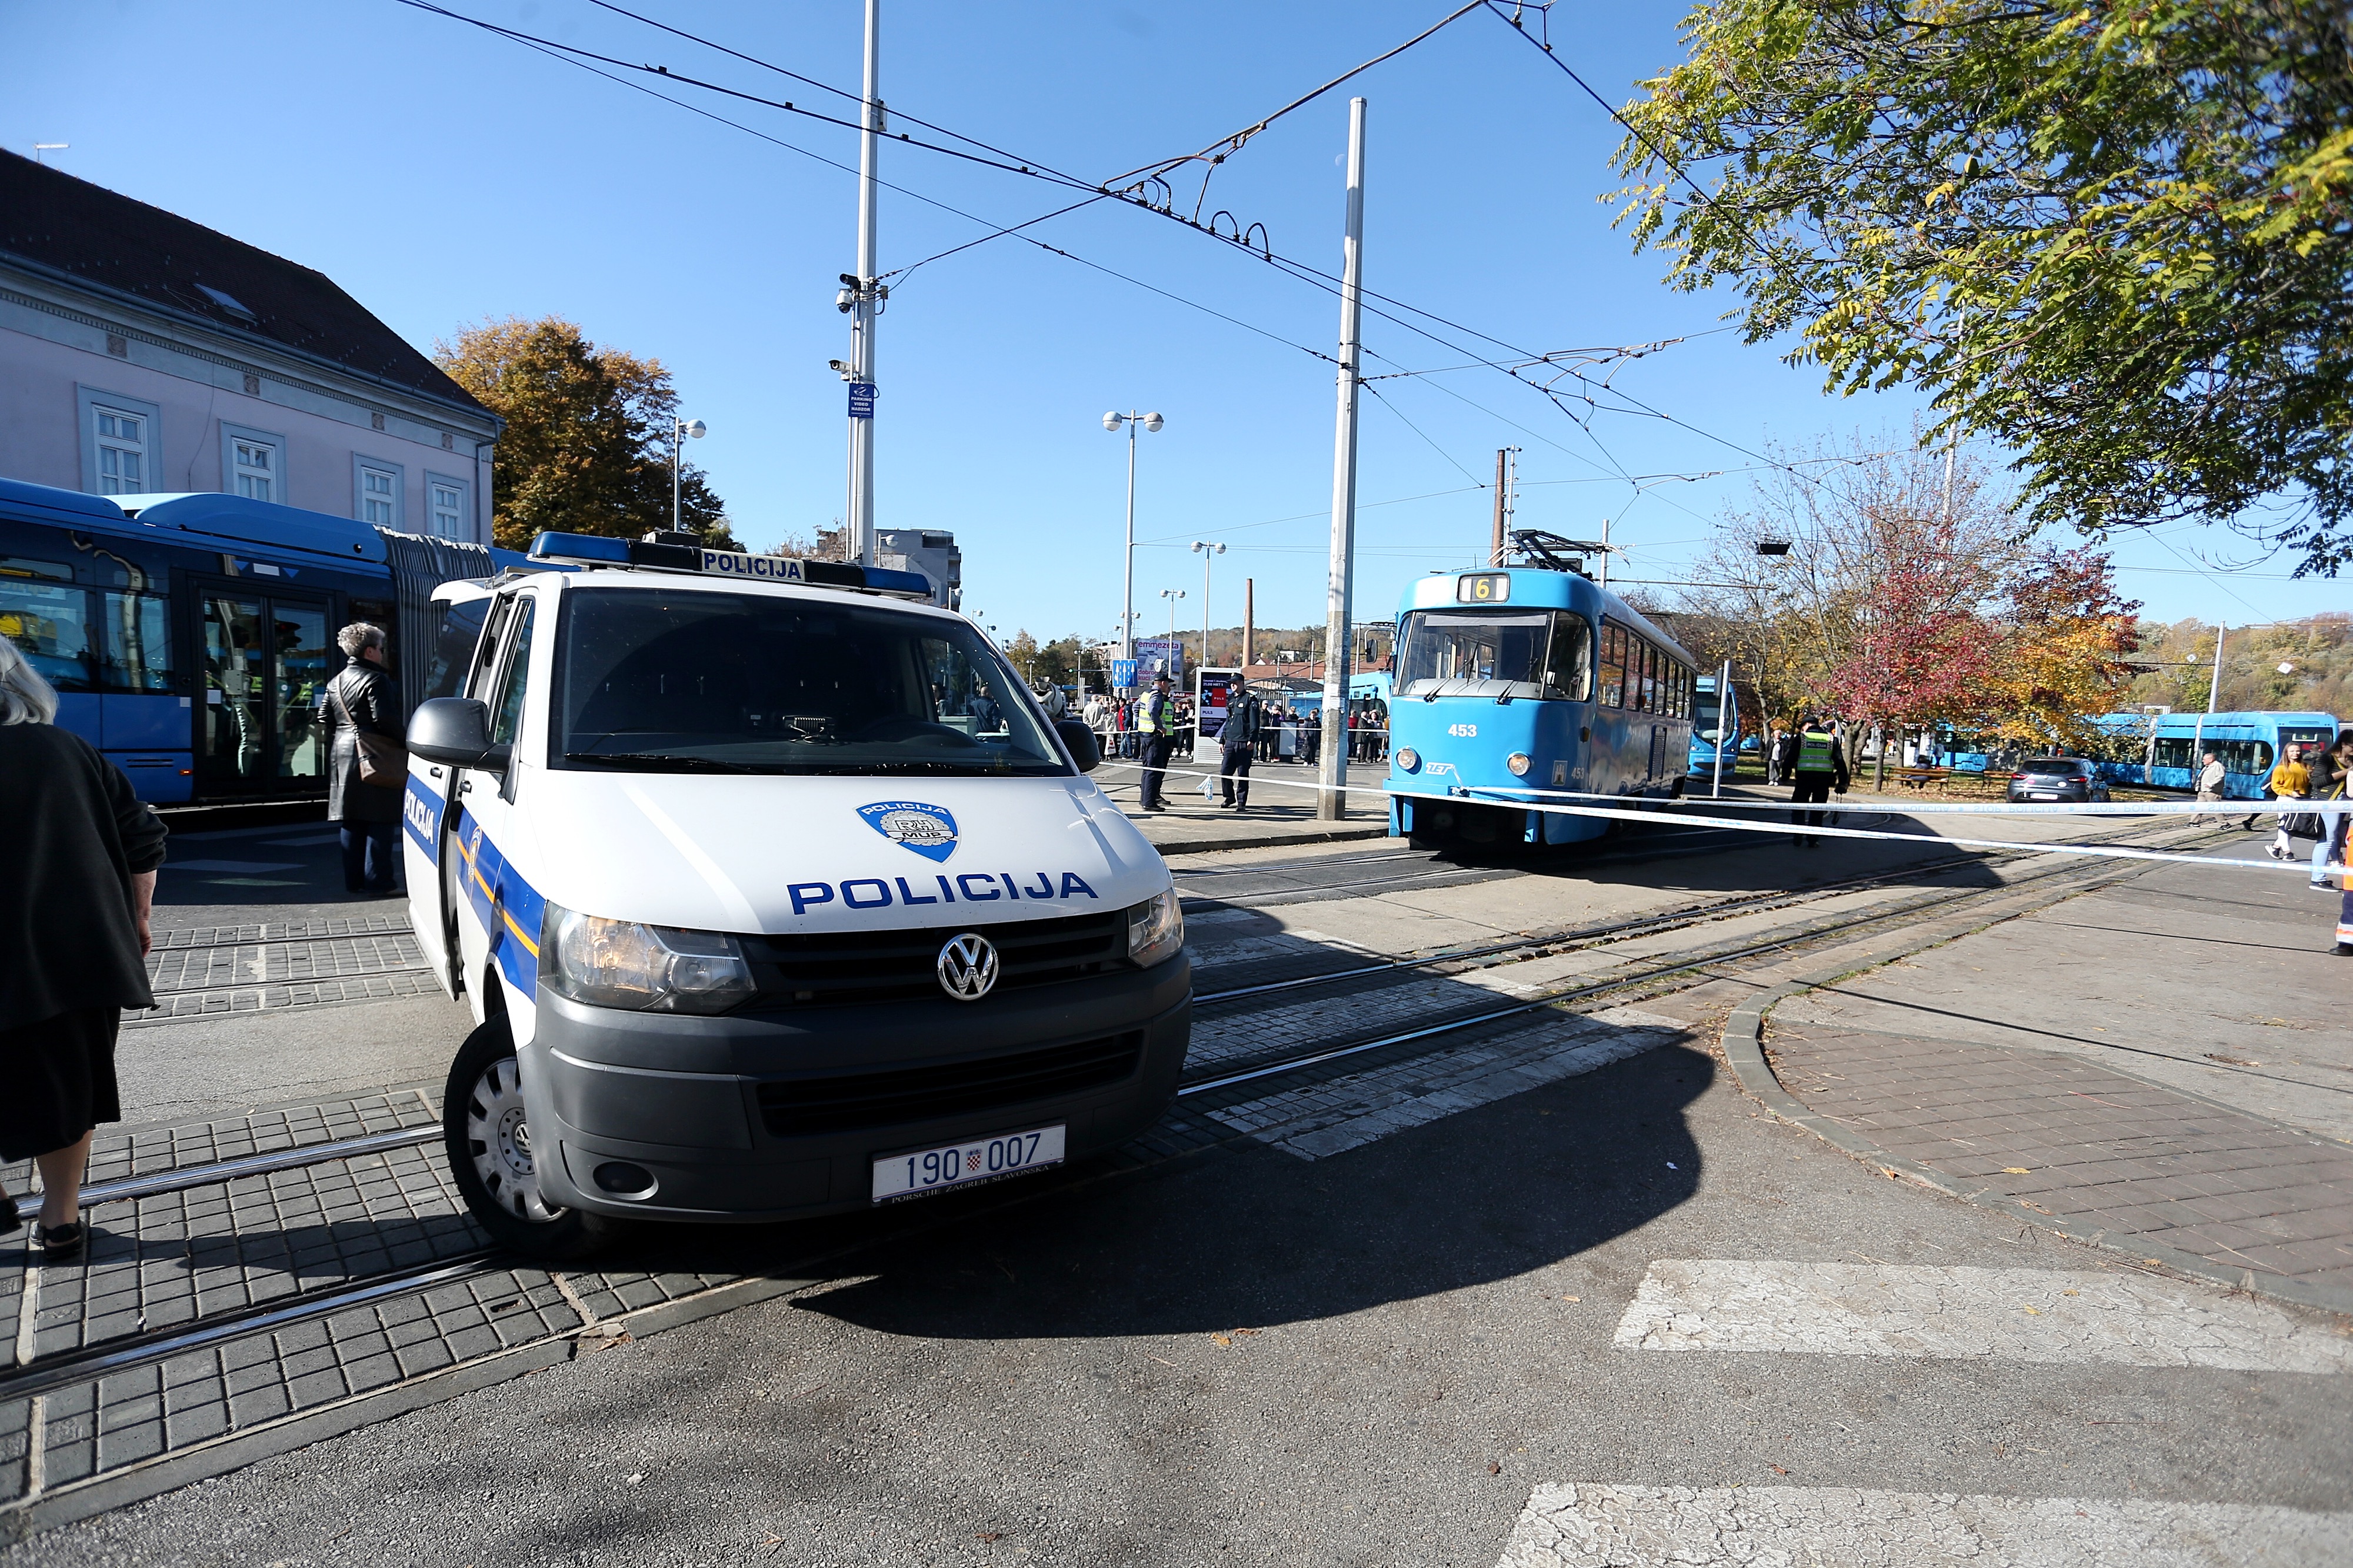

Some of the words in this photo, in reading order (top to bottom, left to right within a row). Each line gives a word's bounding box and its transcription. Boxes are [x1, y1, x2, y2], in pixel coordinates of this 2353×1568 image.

[704, 552, 801, 579] POLICIJA
[1475, 578, 1490, 599] 6
[1448, 724, 1477, 738] 453
[1425, 762, 1454, 775] ZET
[1571, 768, 1584, 779] 453
[404, 788, 434, 845] POLICIJA
[861, 803, 948, 815] POLICIJA
[895, 820, 935, 831] RH
[786, 872, 1099, 915] POLICIJA
[907, 1149, 960, 1188] 190
[988, 1133, 1041, 1172] 007
[892, 1189, 941, 1203] PORSCHE
[945, 1178, 988, 1193] ZAGREB
[992, 1165, 1049, 1182] SLAVONSKA
